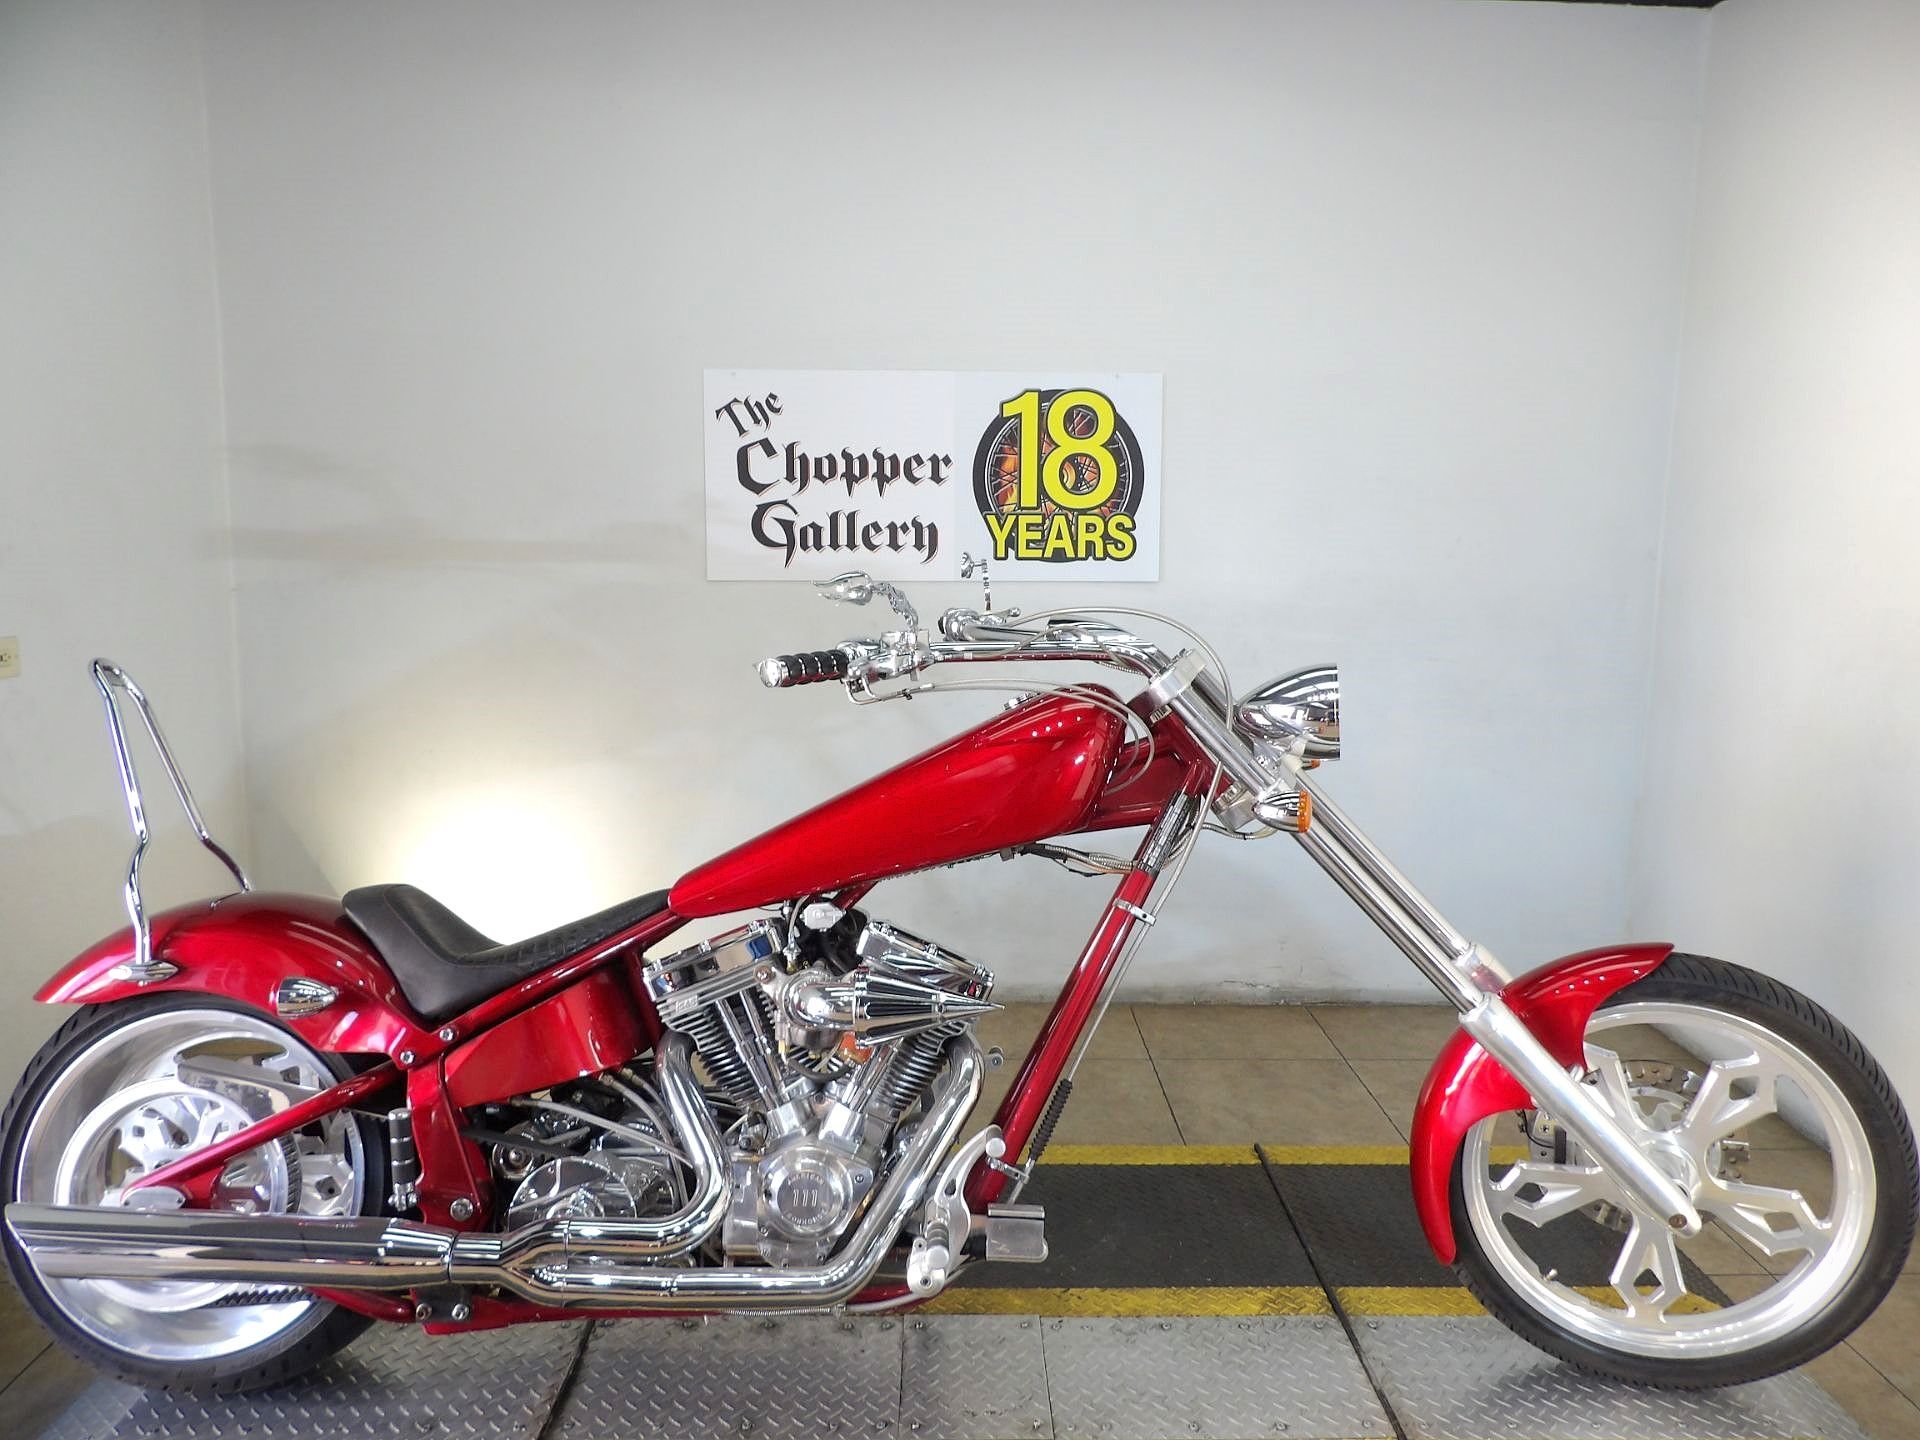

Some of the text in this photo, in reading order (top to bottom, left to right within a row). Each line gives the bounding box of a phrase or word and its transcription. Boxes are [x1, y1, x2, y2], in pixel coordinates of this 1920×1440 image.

[715, 392, 784, 438] The
[736, 437, 954, 498] Chopper
[1001, 387, 1119, 511] 18
[750, 498, 939, 569] Gallery
[984, 510, 1137, 562] YEARS
